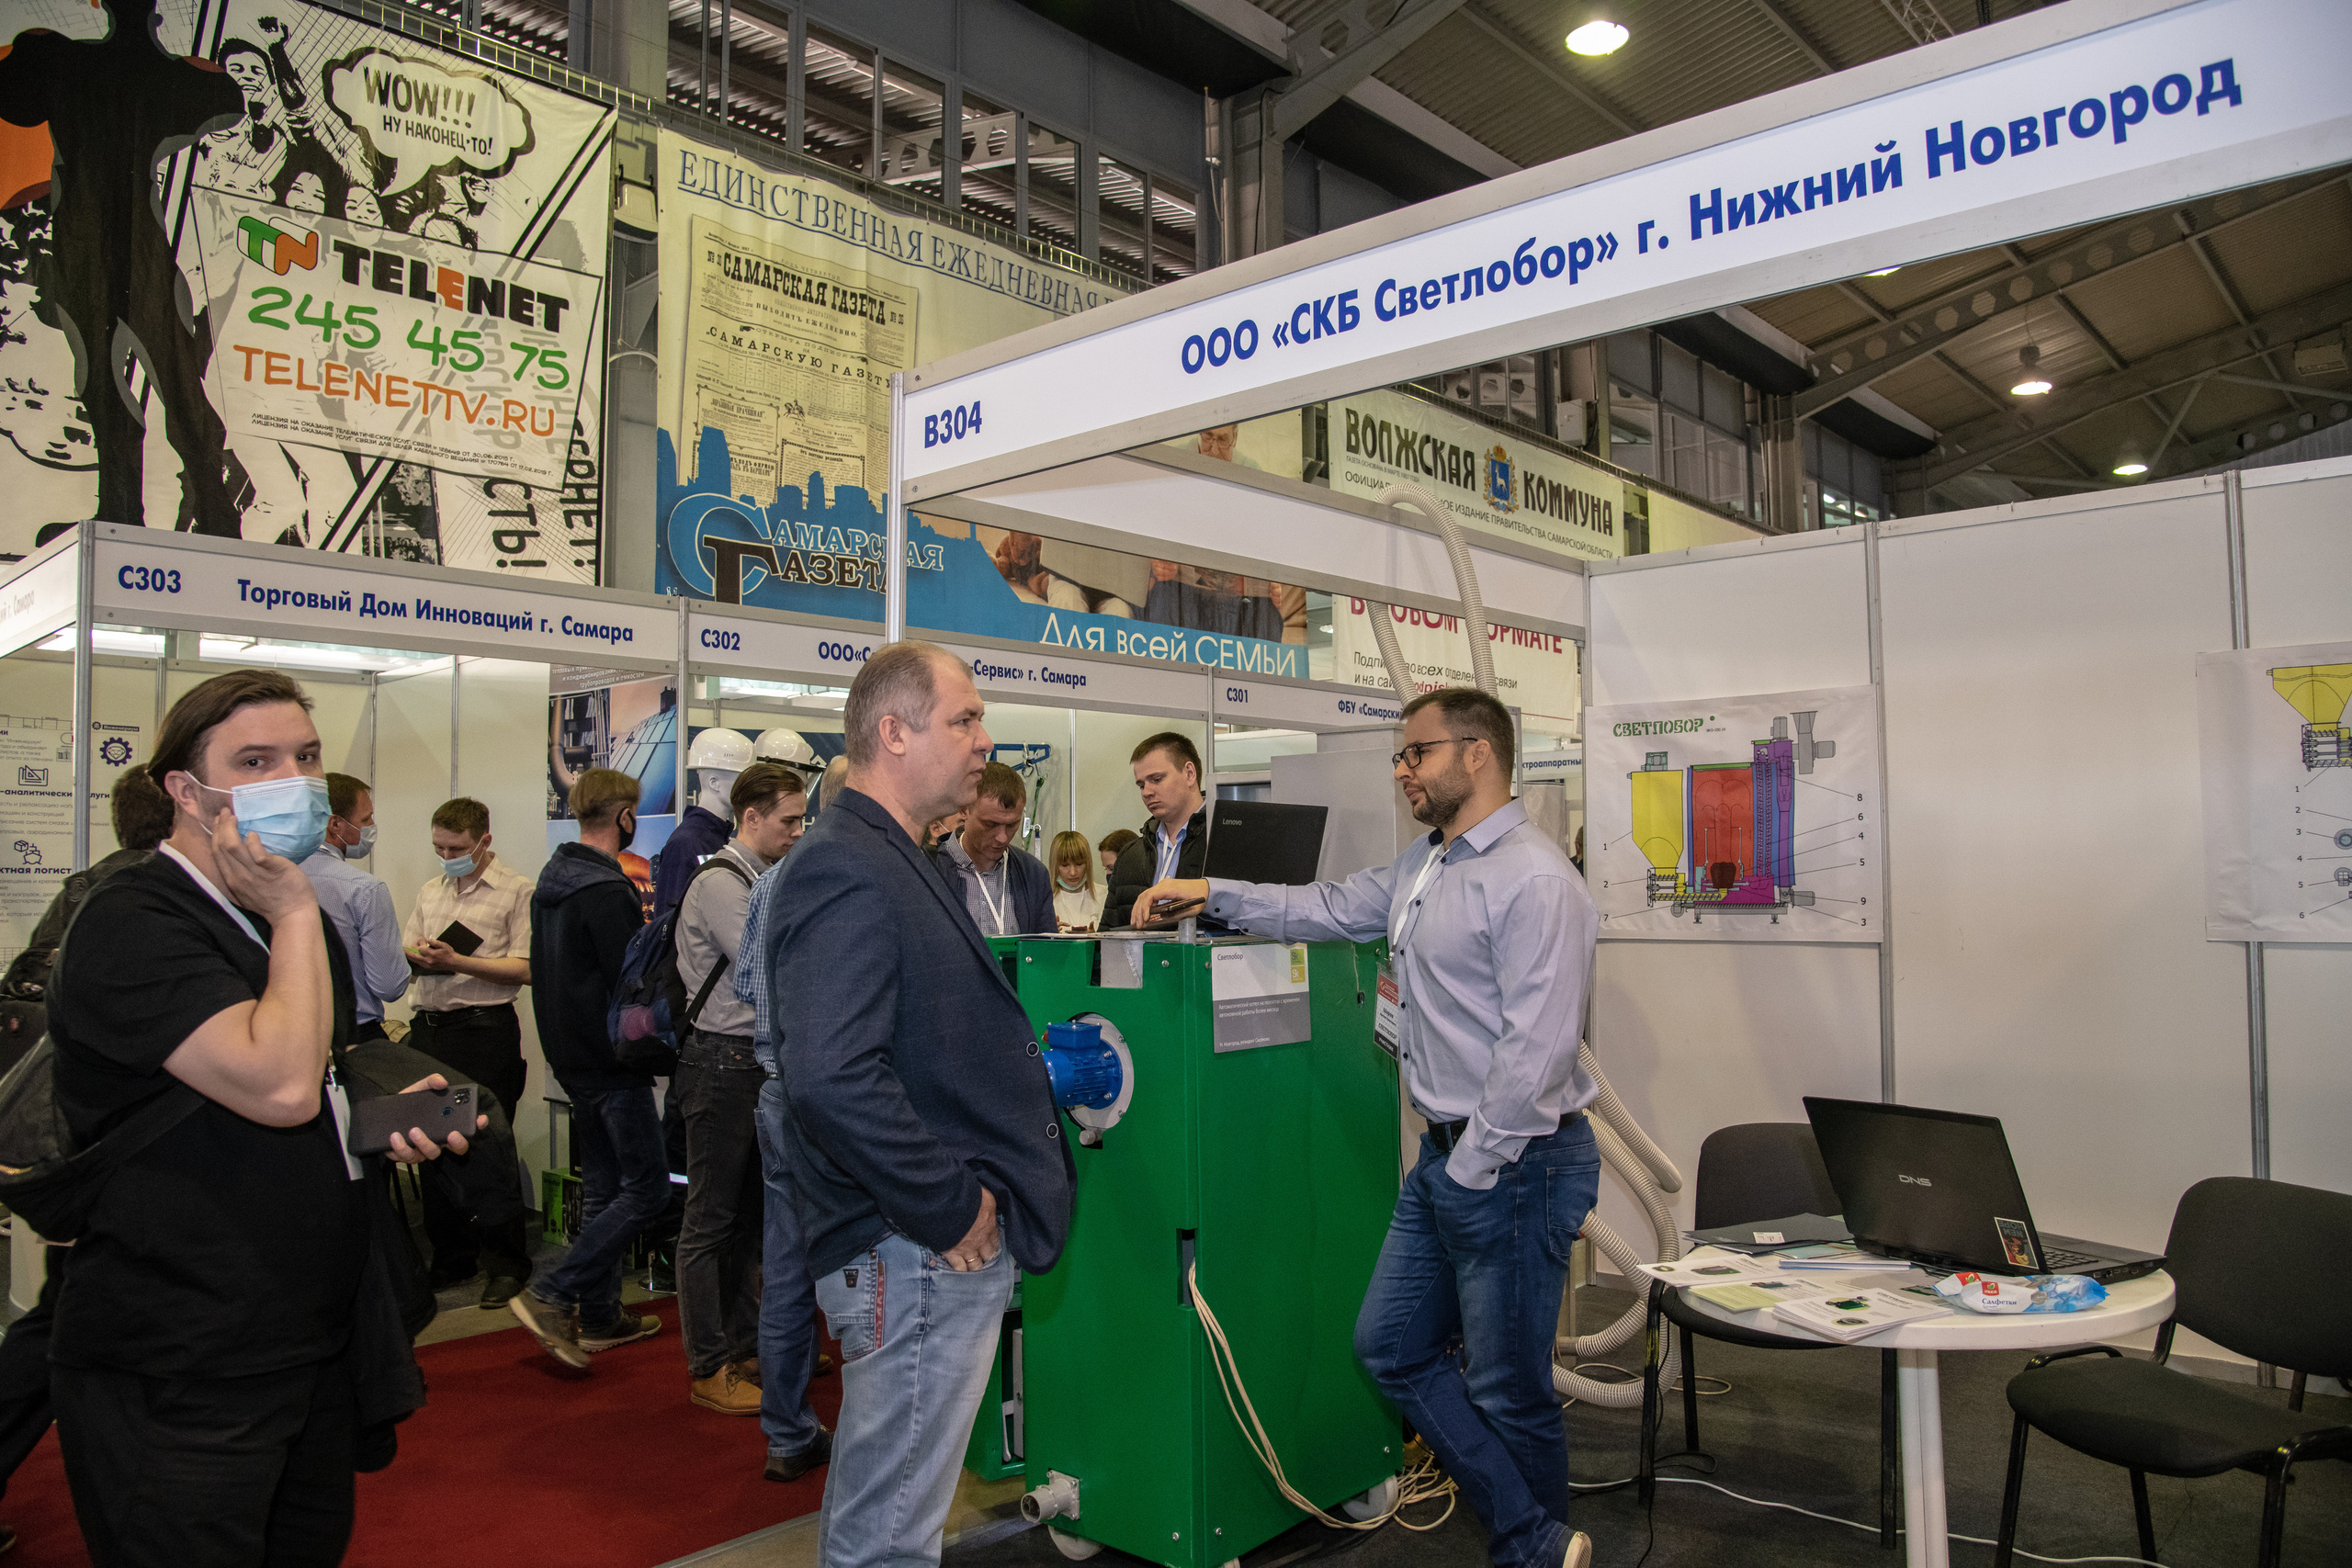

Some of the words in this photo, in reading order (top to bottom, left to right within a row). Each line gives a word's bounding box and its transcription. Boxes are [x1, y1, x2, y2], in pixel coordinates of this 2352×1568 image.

[362, 66, 476, 129] WOW!!!
[382, 115, 401, 133] НУ
[405, 119, 493, 155] НАКОНЕЦ-ТО!
[1181, 319, 1260, 375] ООО
[1271, 288, 1362, 348] «СКБ
[1374, 231, 1619, 323] Светлобор»
[1637, 219, 1669, 255] г.
[1689, 139, 1905, 242] Нижний
[1925, 57, 2243, 180] Новгород
[678, 149, 924, 263] ЕДИНСТВЕННАЯ
[930, 234, 1099, 317] ЕЖЕДНЕВНАЯ
[333, 239, 570, 333] TELENET
[723, 251, 827, 308] САМАРСКАЯ
[831, 285, 886, 325] ГАЗЕТА
[755, 302, 802, 322] ВЫХОДИТЪ
[248, 286, 381, 349] 245
[406, 319, 485, 372] 45
[509, 342, 571, 390] 75
[831, 363, 891, 389] ГАЗЕТУ
[232, 344, 555, 437] TELENETTV.RU
[252, 412, 288, 423] ЛИЦЕНЗИЯ
[301, 421, 334, 432] ОКАЗАНИЕ
[335, 427, 391, 441] ТЕЛЕМАТИЧЕСКИХ
[393, 436, 411, 445] УСЛУГ
[413, 441, 432, 449] СВЯЗИ
[252, 419, 288, 429] ЛИЦЕНЗИЯ
[300, 427, 334, 437] ОКАЗАНИЕ
[355, 437, 378, 446] СВЯЗИ
[1345, 407, 1476, 492] ВОЛЖСКАЯ
[1522, 469, 1614, 537] КОММУНА
[1455, 502, 1490, 524] ИЗДАНИЕ
[1490, 513, 1547, 540] ПРАВИТЕЛЬСТВА
[1547, 530, 1587, 552] САМАРСКОЙ
[1587, 544, 1614, 559] ОБЛАСТИ
[237, 579, 353, 612] Торговый
[359, 592, 408, 619] Дом
[414, 598, 534, 633] Инноваций
[540, 616, 554, 634] г.
[560, 615, 634, 646] Самара
[1117, 630, 1187, 664] всей
[1194, 635, 1296, 678] СЕМЬИ
[818, 641, 872, 662] ООО«С
[969, 659, 1024, 681] -Сервис»
[1027, 669, 1037, 682] г.
[1040, 667, 1087, 689] Самара
[1354, 651, 1386, 670] Подпи
[1417, 664, 1444, 676] всех
[1444, 667, 1476, 682] отделен
[1354, 673, 1361, 684] и
[1362, 675, 1374, 686] на
[1338, 699, 1356, 714] ФБУ
[1521, 758, 1583, 771] ктроаппаратны
[0, 788, 73, 799] -аналитически
[1857, 793, 1863, 801] 8
[1858, 812, 1864, 820] 6
[2295, 806, 2301, 814] 2
[1222, 818, 1243, 826] Lenovo
[1858, 831, 1864, 840] 4
[2296, 828, 2301, 836] 3
[1603, 842, 1608, 851] 1
[1860, 858, 1865, 866] 5
[1603, 880, 1609, 888] 2
[1860, 897, 1867, 906] 9
[2299, 911, 2305, 919] 6
[1860, 919, 1867, 927] 3
[1217, 953, 1244, 962] Светлобор
[1292, 969, 1300, 978] Sk
[1897, 1174, 1932, 1187] DNS
[1981, 1298, 2018, 1306] Салфетки
